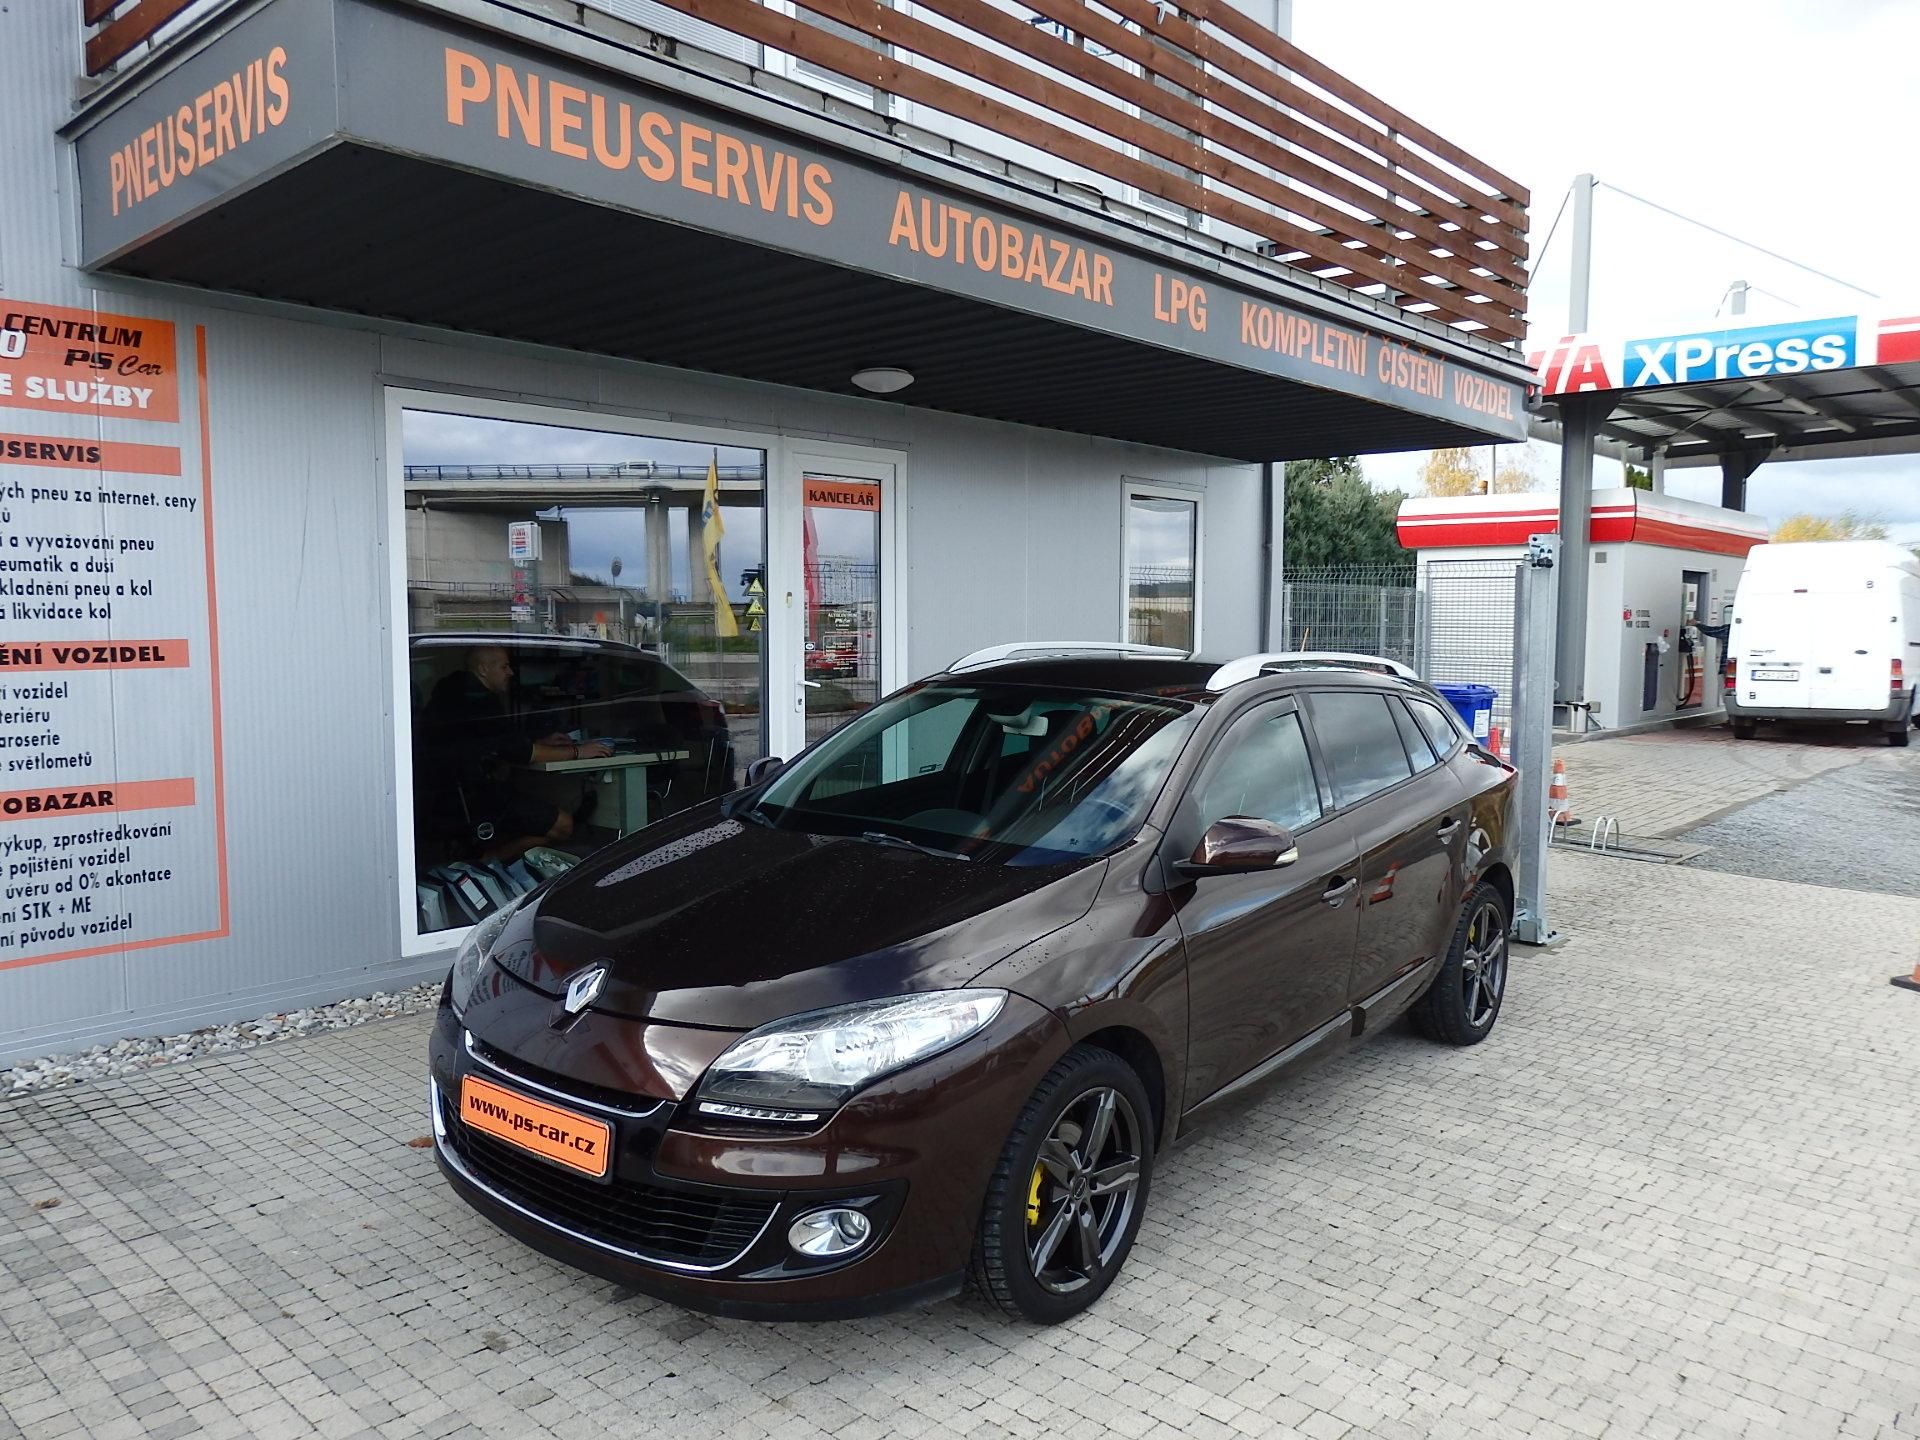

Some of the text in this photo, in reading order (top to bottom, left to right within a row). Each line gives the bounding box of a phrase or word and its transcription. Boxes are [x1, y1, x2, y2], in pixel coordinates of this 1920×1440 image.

[110, 46, 289, 217] PNEUSERVIS
[445, 47, 1514, 421] PNEUSERVIS AUTOBAZAR LPG KOMPLETNÍ ČIŠTĚNÍ VOZIDEL
[5, 313, 143, 348] CENTRUM
[64, 349, 163, 376] PS Car
[1632, 334, 1847, 387] XPress
[26, 376, 153, 409] SLUŽBY
[31, 487, 68, 508] pneu
[75, 490, 92, 503] za
[99, 487, 160, 507] internet.
[164, 495, 197, 512] ceny
[809, 489, 874, 506] KANCELÁŘ
[9, 536, 19, 548] a
[26, 534, 114, 552] vyvažování
[120, 536, 155, 553] pneu
[0, 553, 114, 573] eumatik a duší
[75, 582, 110, 600] pneu
[116, 585, 124, 595] a
[130, 580, 152, 595] kol
[13, 603, 83, 620] likvidace
[89, 603, 111, 619] kol
[52, 646, 165, 664] VOZIDEL
[13, 681, 68, 699] vozidel
[9, 752, 92, 772] světlometů
[0, 790, 114, 814] OBAZAR
[53, 821, 171, 848] zprostředkování
[10, 851, 73, 877] pojištění
[79, 847, 130, 867] vozidel
[6, 868, 171, 899] úvěru od 0% akontace
[22, 901, 52, 920] STK
[71, 896, 92, 914] ME
[21, 925, 75, 949] původu
[81, 913, 132, 933] vozidel
[469, 1095, 595, 1155] www.ps-car.cz
